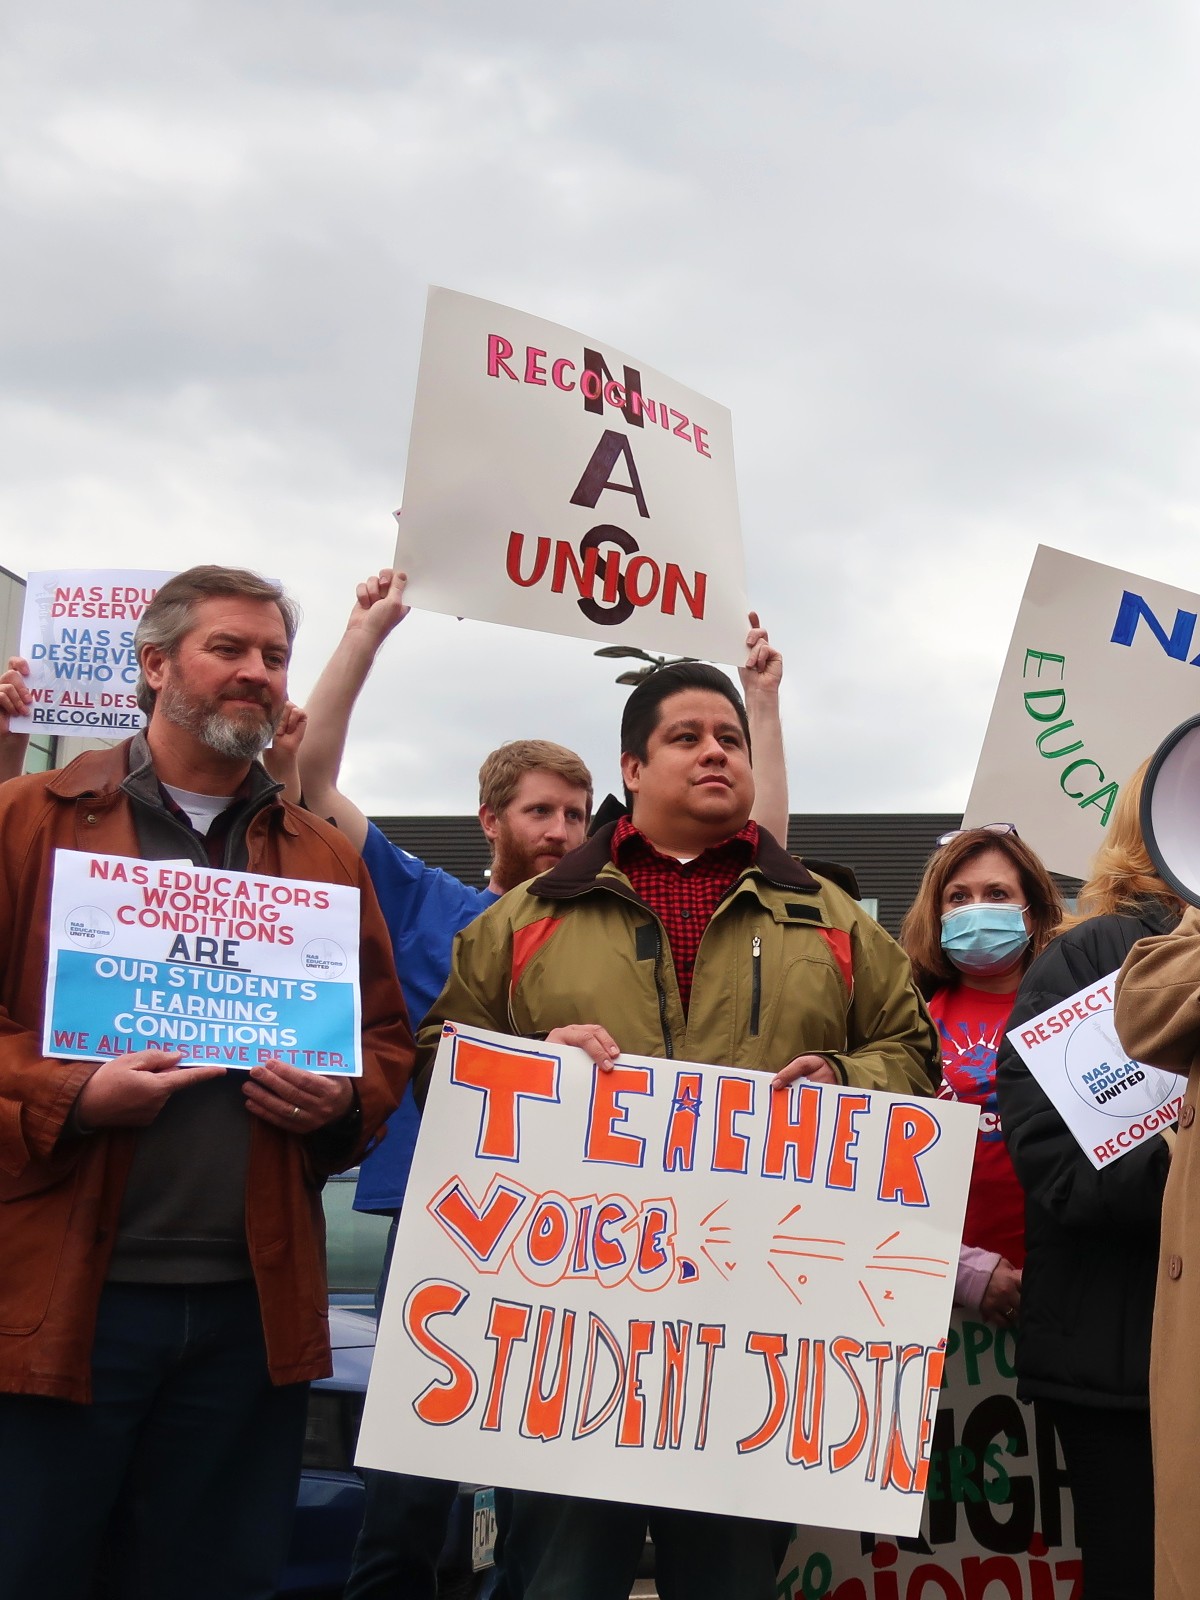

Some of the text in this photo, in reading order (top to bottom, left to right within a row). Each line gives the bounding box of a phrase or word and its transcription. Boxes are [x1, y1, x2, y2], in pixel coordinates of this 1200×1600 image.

[486, 333, 712, 459] RECOGNIZE
[506, 531, 708, 620] UNION
[55, 587, 103, 602] NAS
[61, 628, 110, 646] NAS
[54, 662, 113, 682] WHO
[59, 691, 95, 708] ALL
[33, 708, 140, 728] RECOGNIZE
[1023, 648, 1120, 827] EDUCA
[90, 859, 330, 909] NAS EDUCATORS
[143, 887, 280, 922] WORKING
[117, 905, 294, 945] CONDITIONS
[168, 934, 241, 966] ARE
[96, 957, 317, 1001] OUR STUDENTS
[134, 988, 278, 1022] LEARNING
[1020, 986, 1113, 1049] RESPECT
[114, 1013, 297, 1047] CONDITIONS
[54, 1031, 349, 1068] WE ALL DESERVE BETTER.
[1082, 1062, 1111, 1084] NAS
[1095, 1070, 1146, 1105] UNITED
[452, 1035, 941, 1207] TEACHER
[403, 1278, 725, 1451] STUDENT
